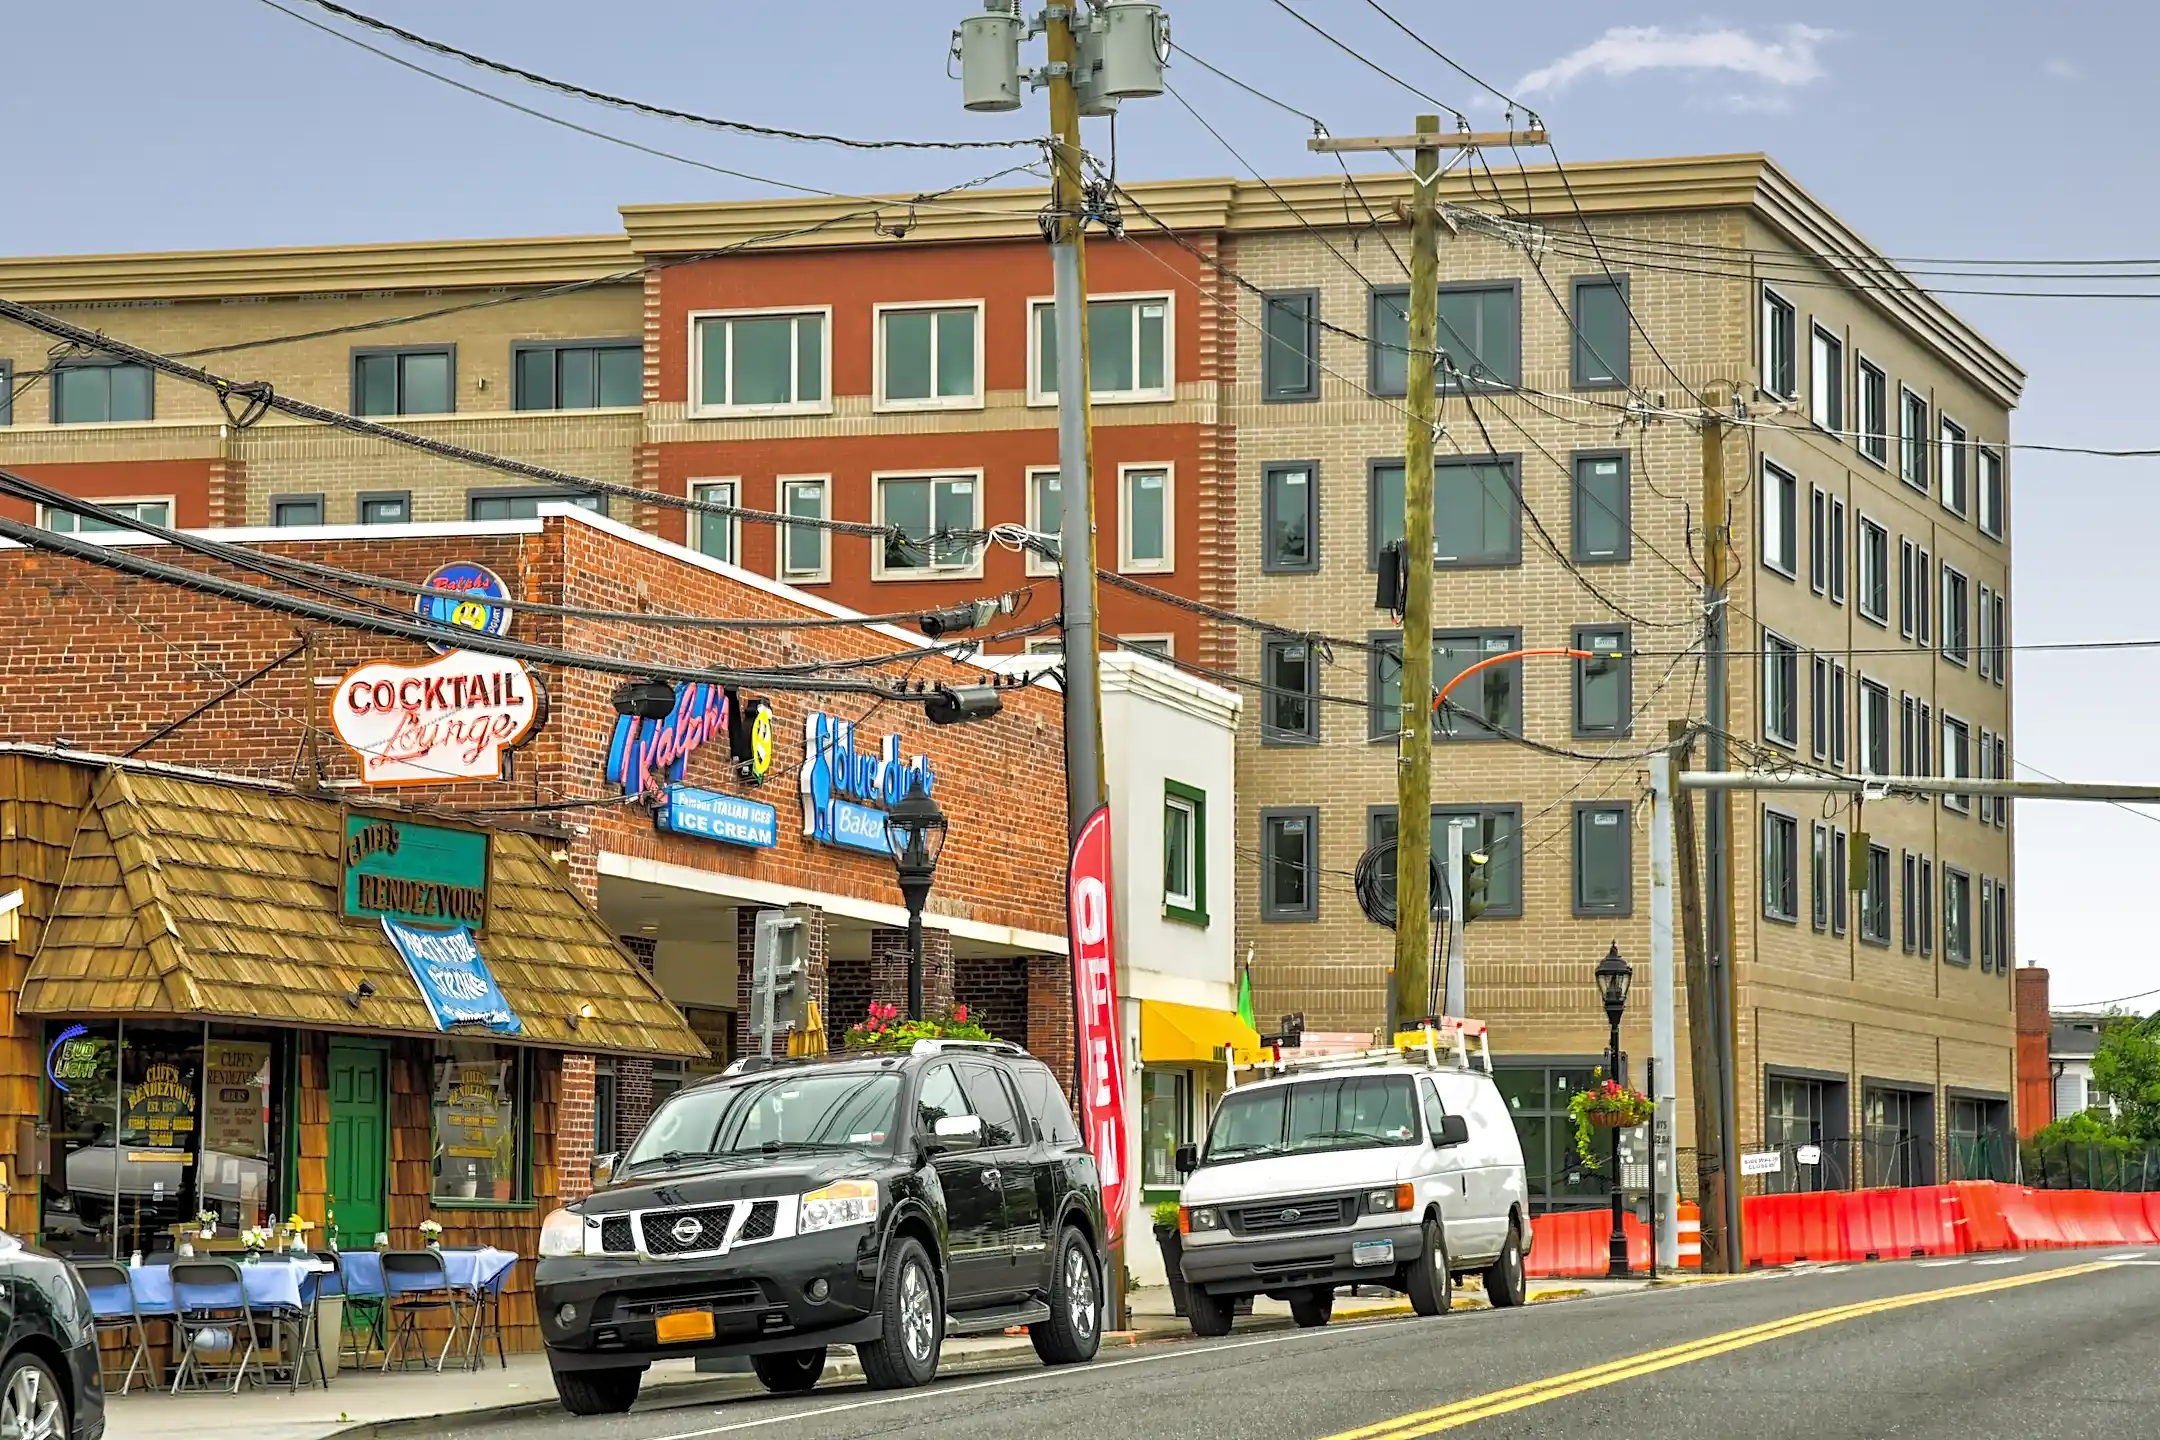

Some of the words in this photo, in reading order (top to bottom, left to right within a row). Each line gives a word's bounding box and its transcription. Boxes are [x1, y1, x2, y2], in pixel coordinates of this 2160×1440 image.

[487, 608, 501, 634] OGURT
[347, 671, 525, 716] COCKTAIL
[368, 711, 518, 770] Lounge
[832, 716, 879, 800] blue
[713, 800, 749, 820] ITALIAN
[678, 811, 708, 832] ICE
[712, 819, 772, 844] CREAM
[839, 806, 889, 848] Baker
[359, 874, 485, 922] RENDEZVOUS
[1075, 875, 1120, 1187] OPEN
[63, 1038, 96, 1061] BUD
[54, 1057, 98, 1078] LIGHT
[146, 1063, 179, 1083] CLIFF'S
[128, 1081, 196, 1112] RENDEZVOUS
